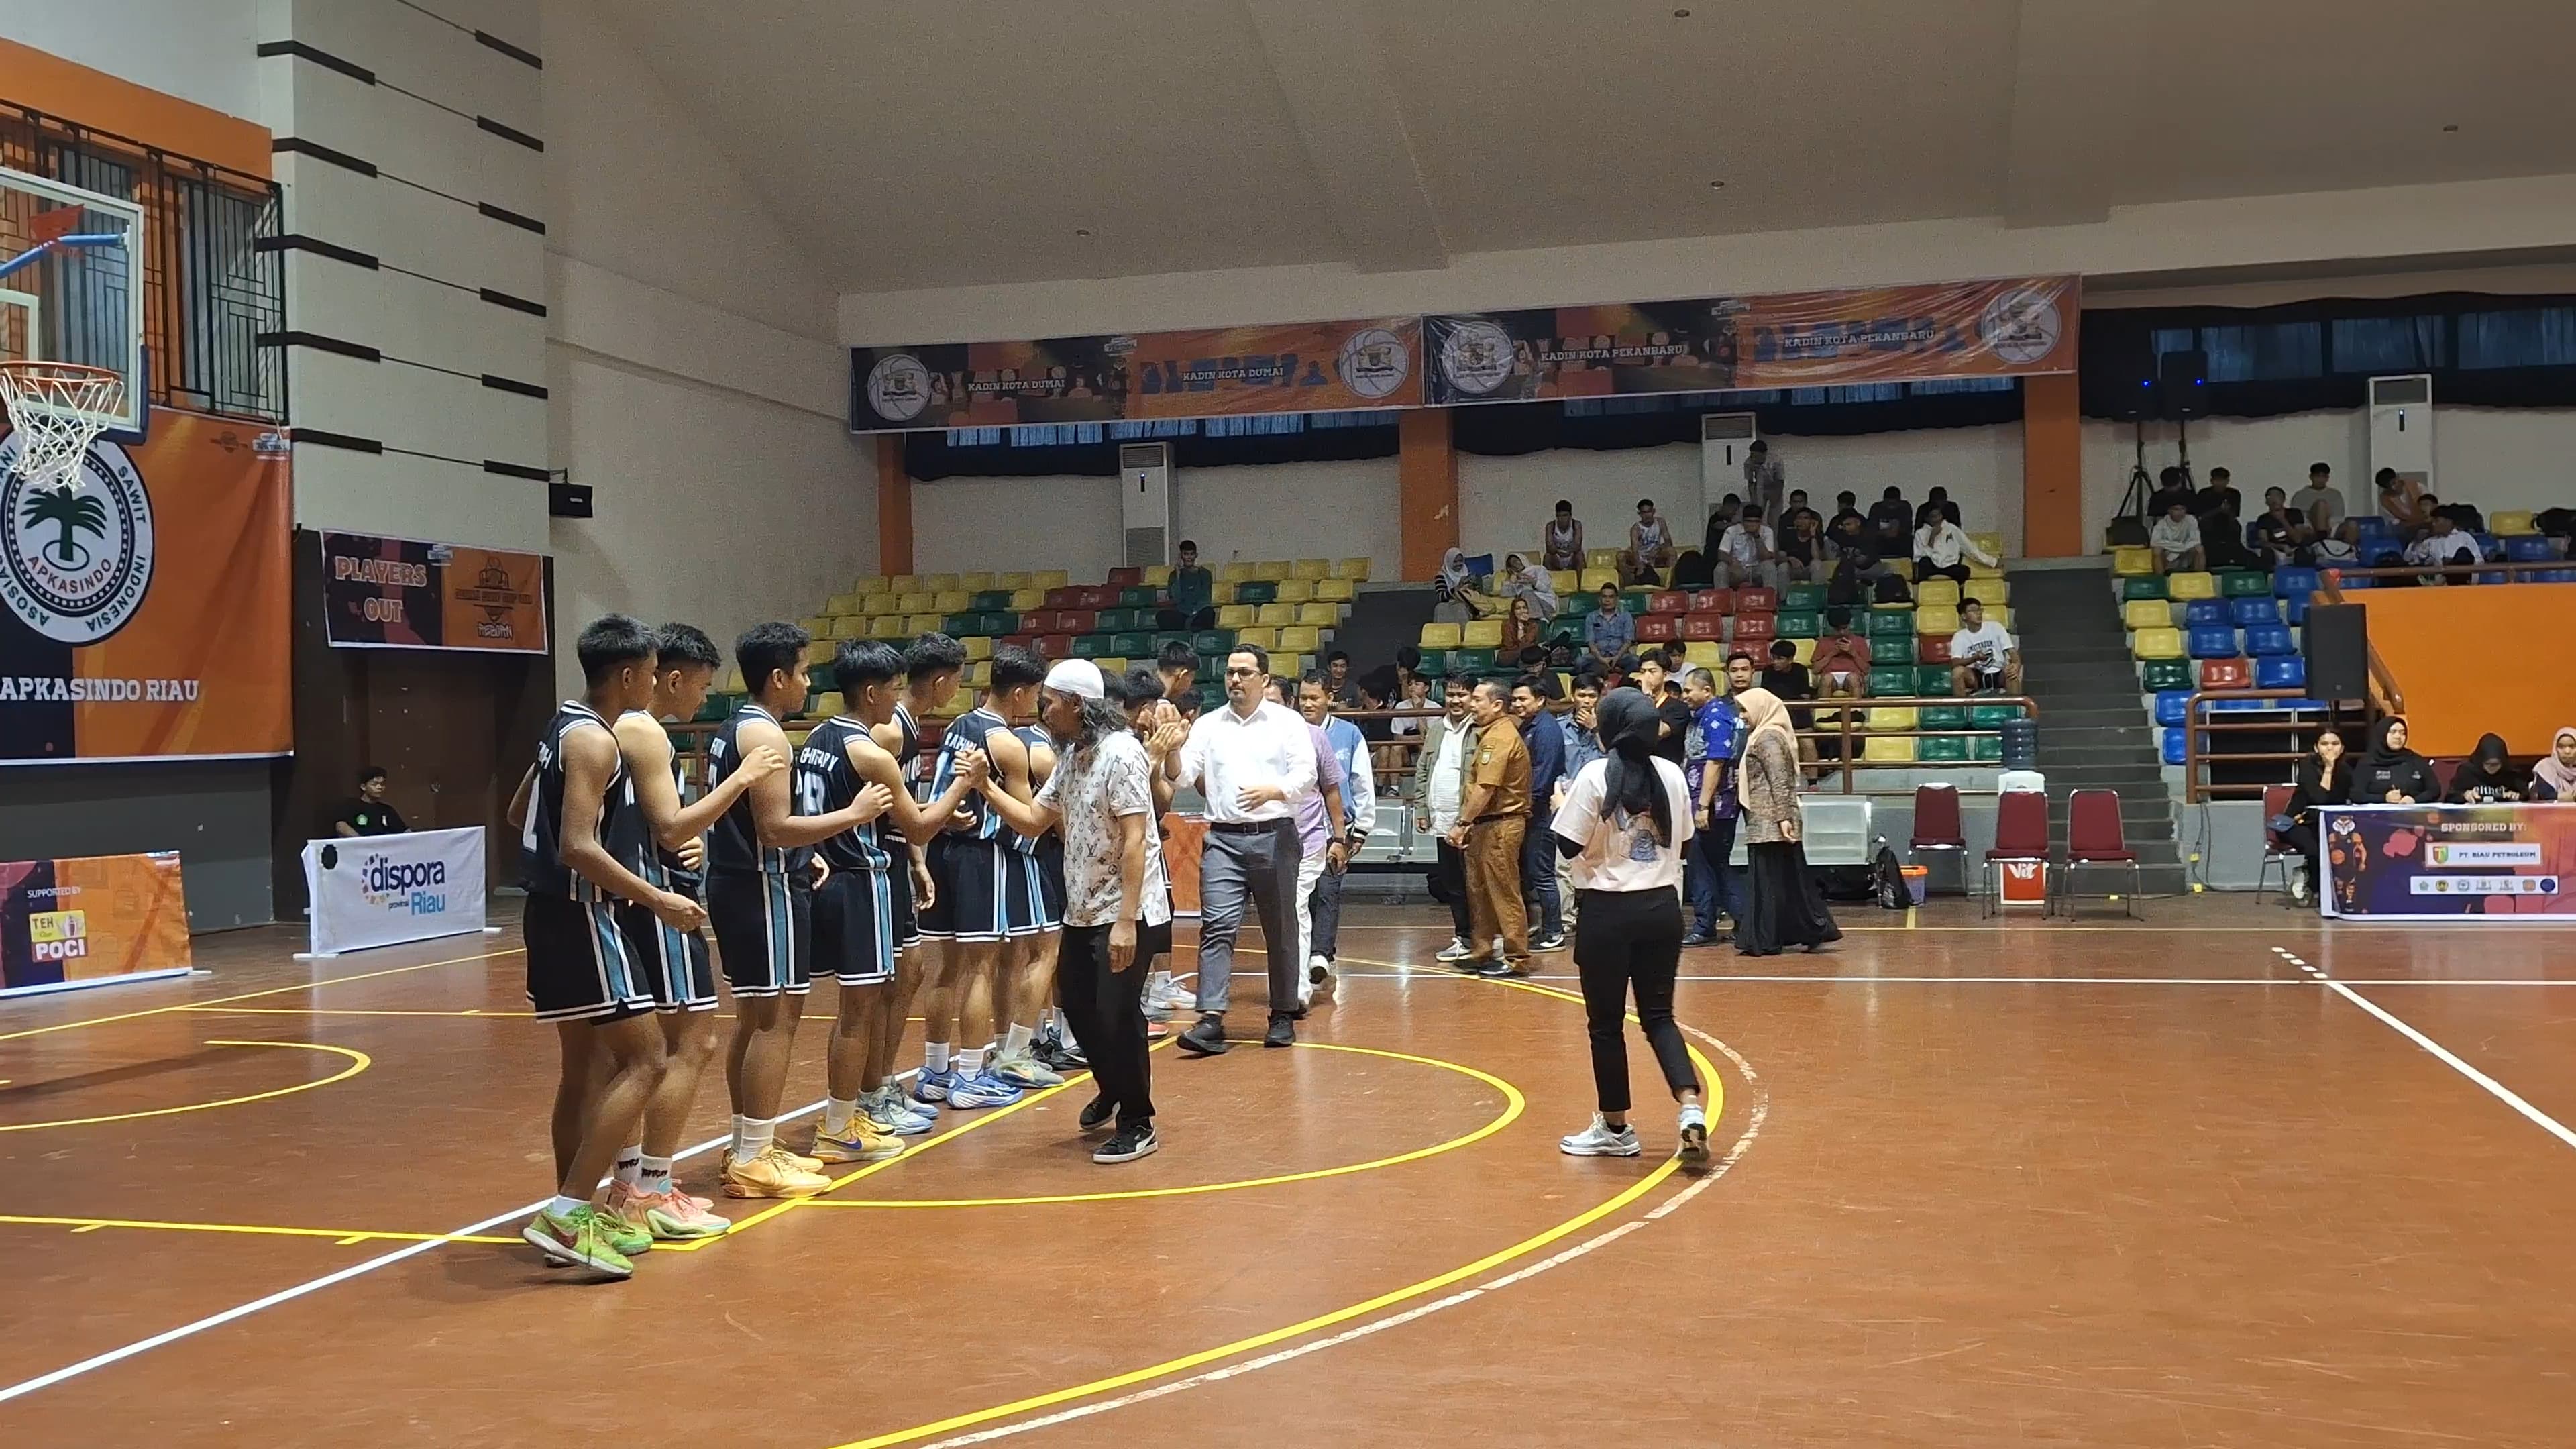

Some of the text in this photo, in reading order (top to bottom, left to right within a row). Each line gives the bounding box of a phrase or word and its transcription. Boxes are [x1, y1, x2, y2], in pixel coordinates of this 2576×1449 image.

[1784, 330, 1935, 347] KADIN KOTA PEKANBARU
[1541, 345, 1688, 362] KADIN KOTA PEKANBARU
[1183, 367, 1283, 381] KADIN KOTA DUMAI
[968, 380, 1065, 392] KADIN KOTA DUMAI
[118, 466, 146, 523] SAWIT
[28, 556, 111, 594] APKASINDO
[335, 555, 427, 588] PLAYERS
[85, 555, 146, 632] INDONESIA
[363, 597, 404, 623] OUT
[0, 677, 199, 702] APKASINDO RIAU
[2440, 822, 2528, 833] SPONSORED BY:
[370, 857, 445, 896] dispora
[27, 887, 70, 898] SUPPORTED
[411, 892, 445, 916] Riau
[32, 916, 54, 930] TEH
[35, 939, 86, 960] POCI
